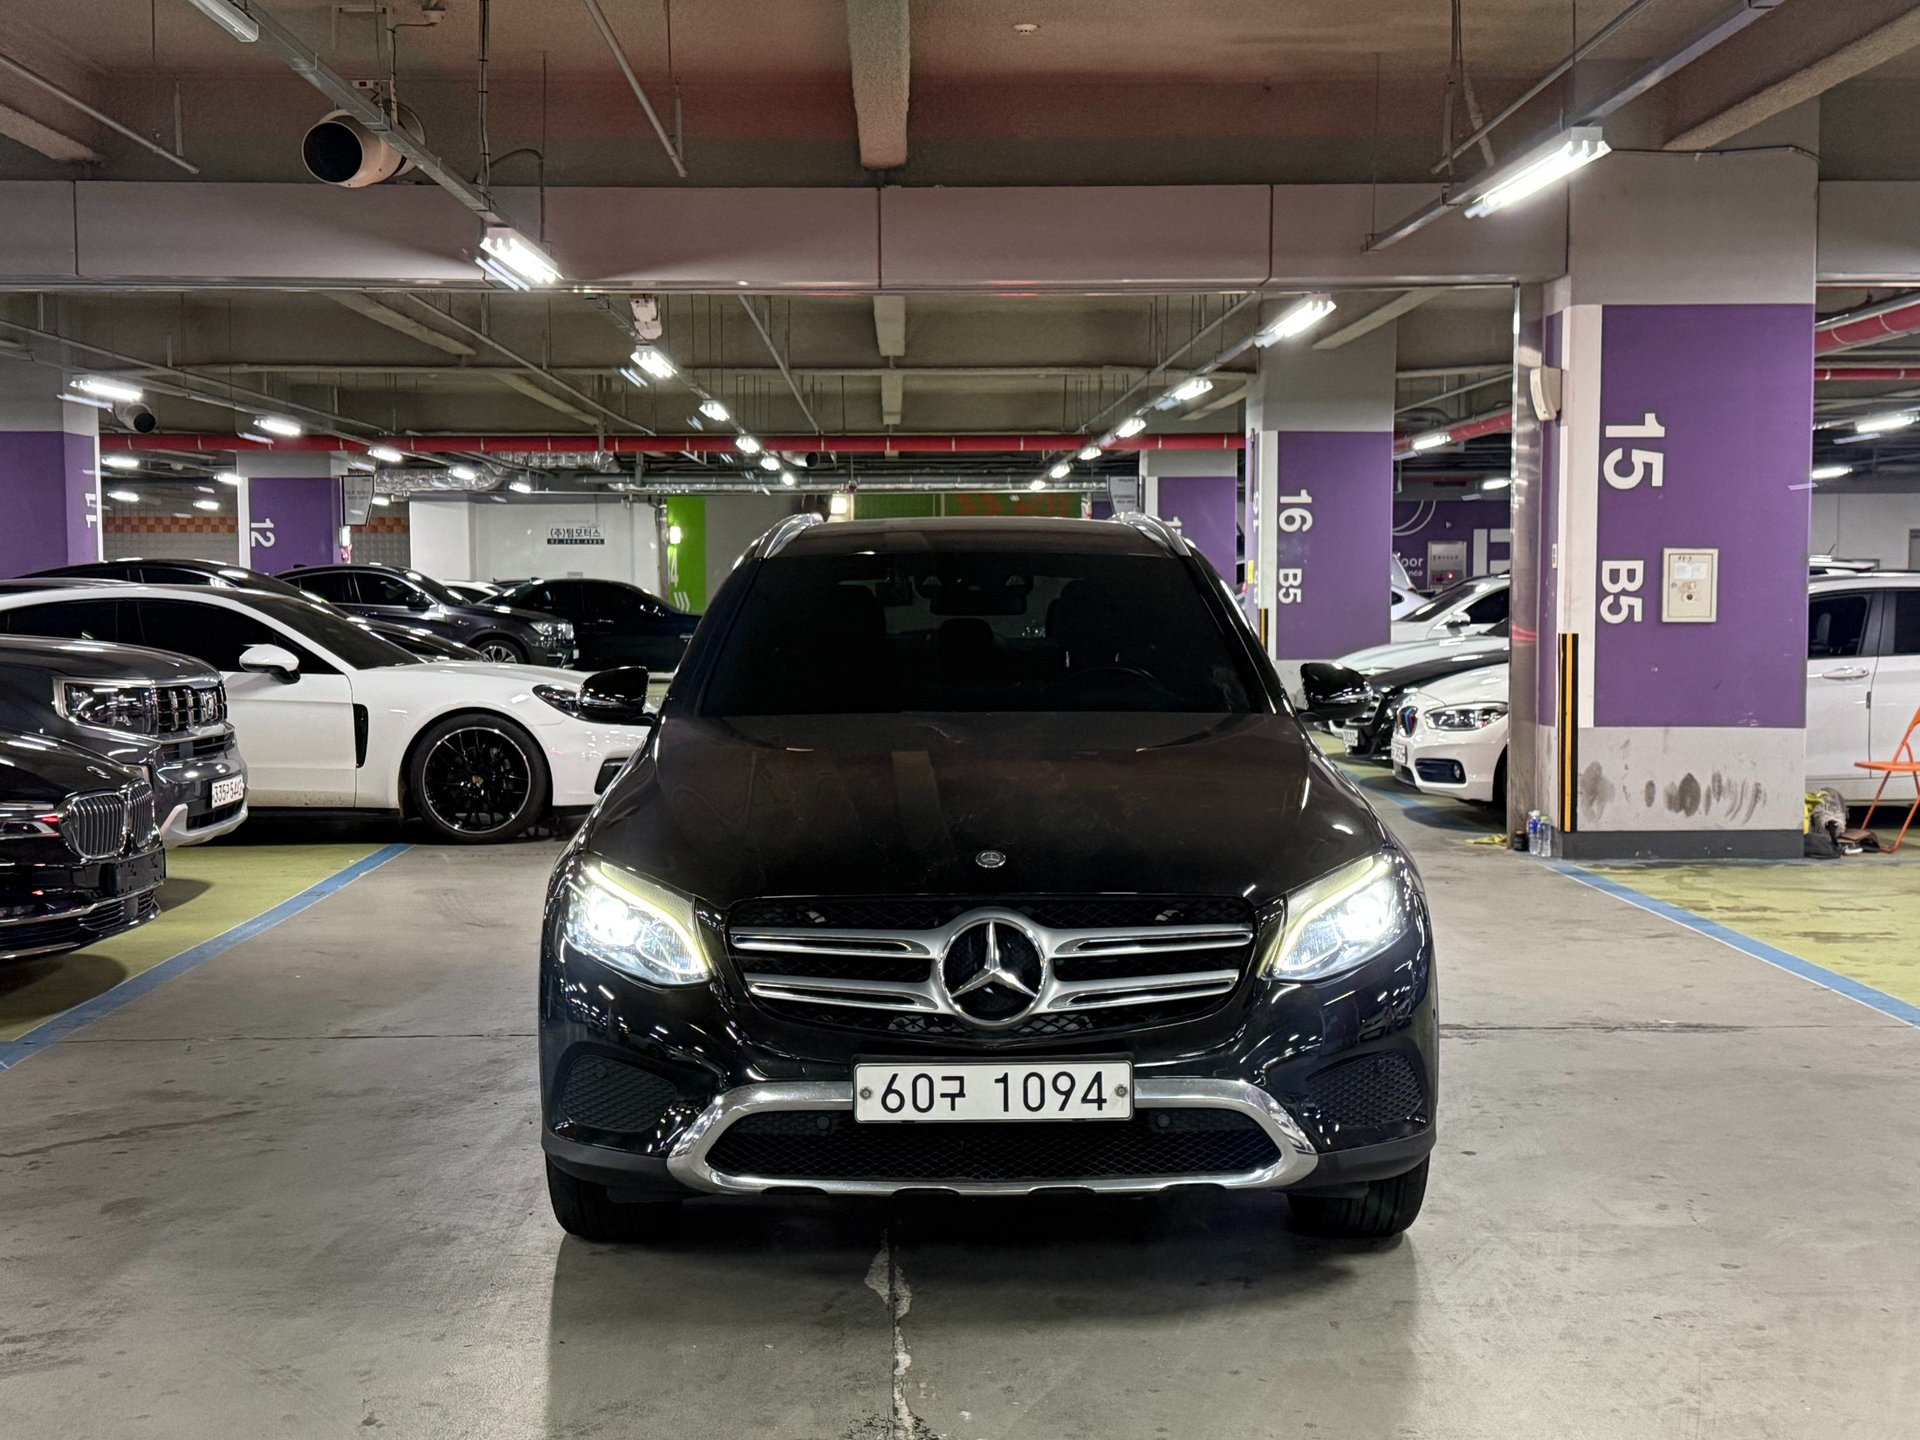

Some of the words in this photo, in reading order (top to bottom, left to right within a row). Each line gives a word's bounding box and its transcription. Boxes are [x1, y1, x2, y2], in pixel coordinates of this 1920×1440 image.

[1603, 413, 1665, 490] 15
[1279, 488, 1313, 532] 16
[251, 518, 275, 548] 12
[1278, 568, 1302, 604] B5
[1600, 560, 1644, 624] B5
[881, 1073, 966, 1113] 60구
[994, 1071, 1107, 1112] 1094
